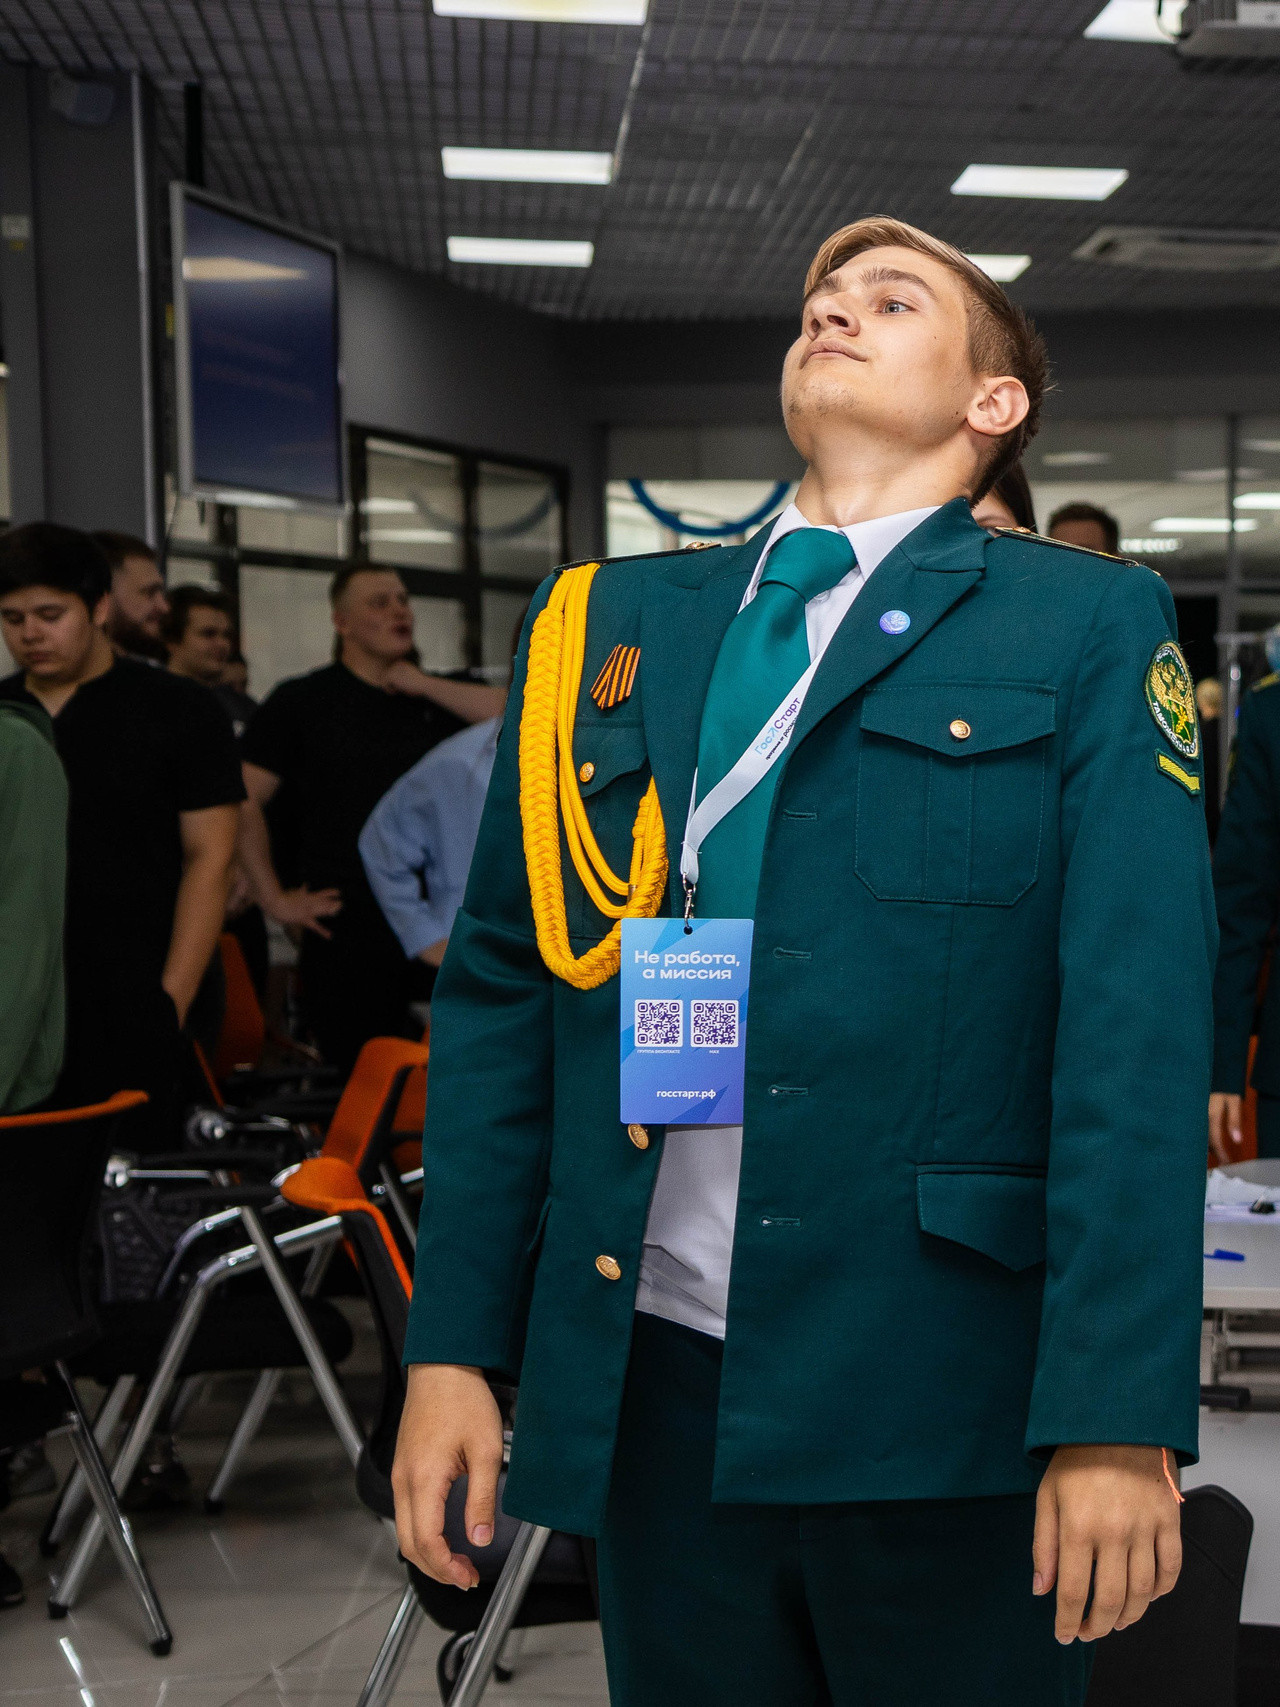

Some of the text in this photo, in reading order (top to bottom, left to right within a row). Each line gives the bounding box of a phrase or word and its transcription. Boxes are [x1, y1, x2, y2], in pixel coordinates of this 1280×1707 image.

[634, 950, 740, 967] Не работа,
[642, 969, 732, 980] а миссия
[656, 1088, 716, 1100] госстарт.рф
